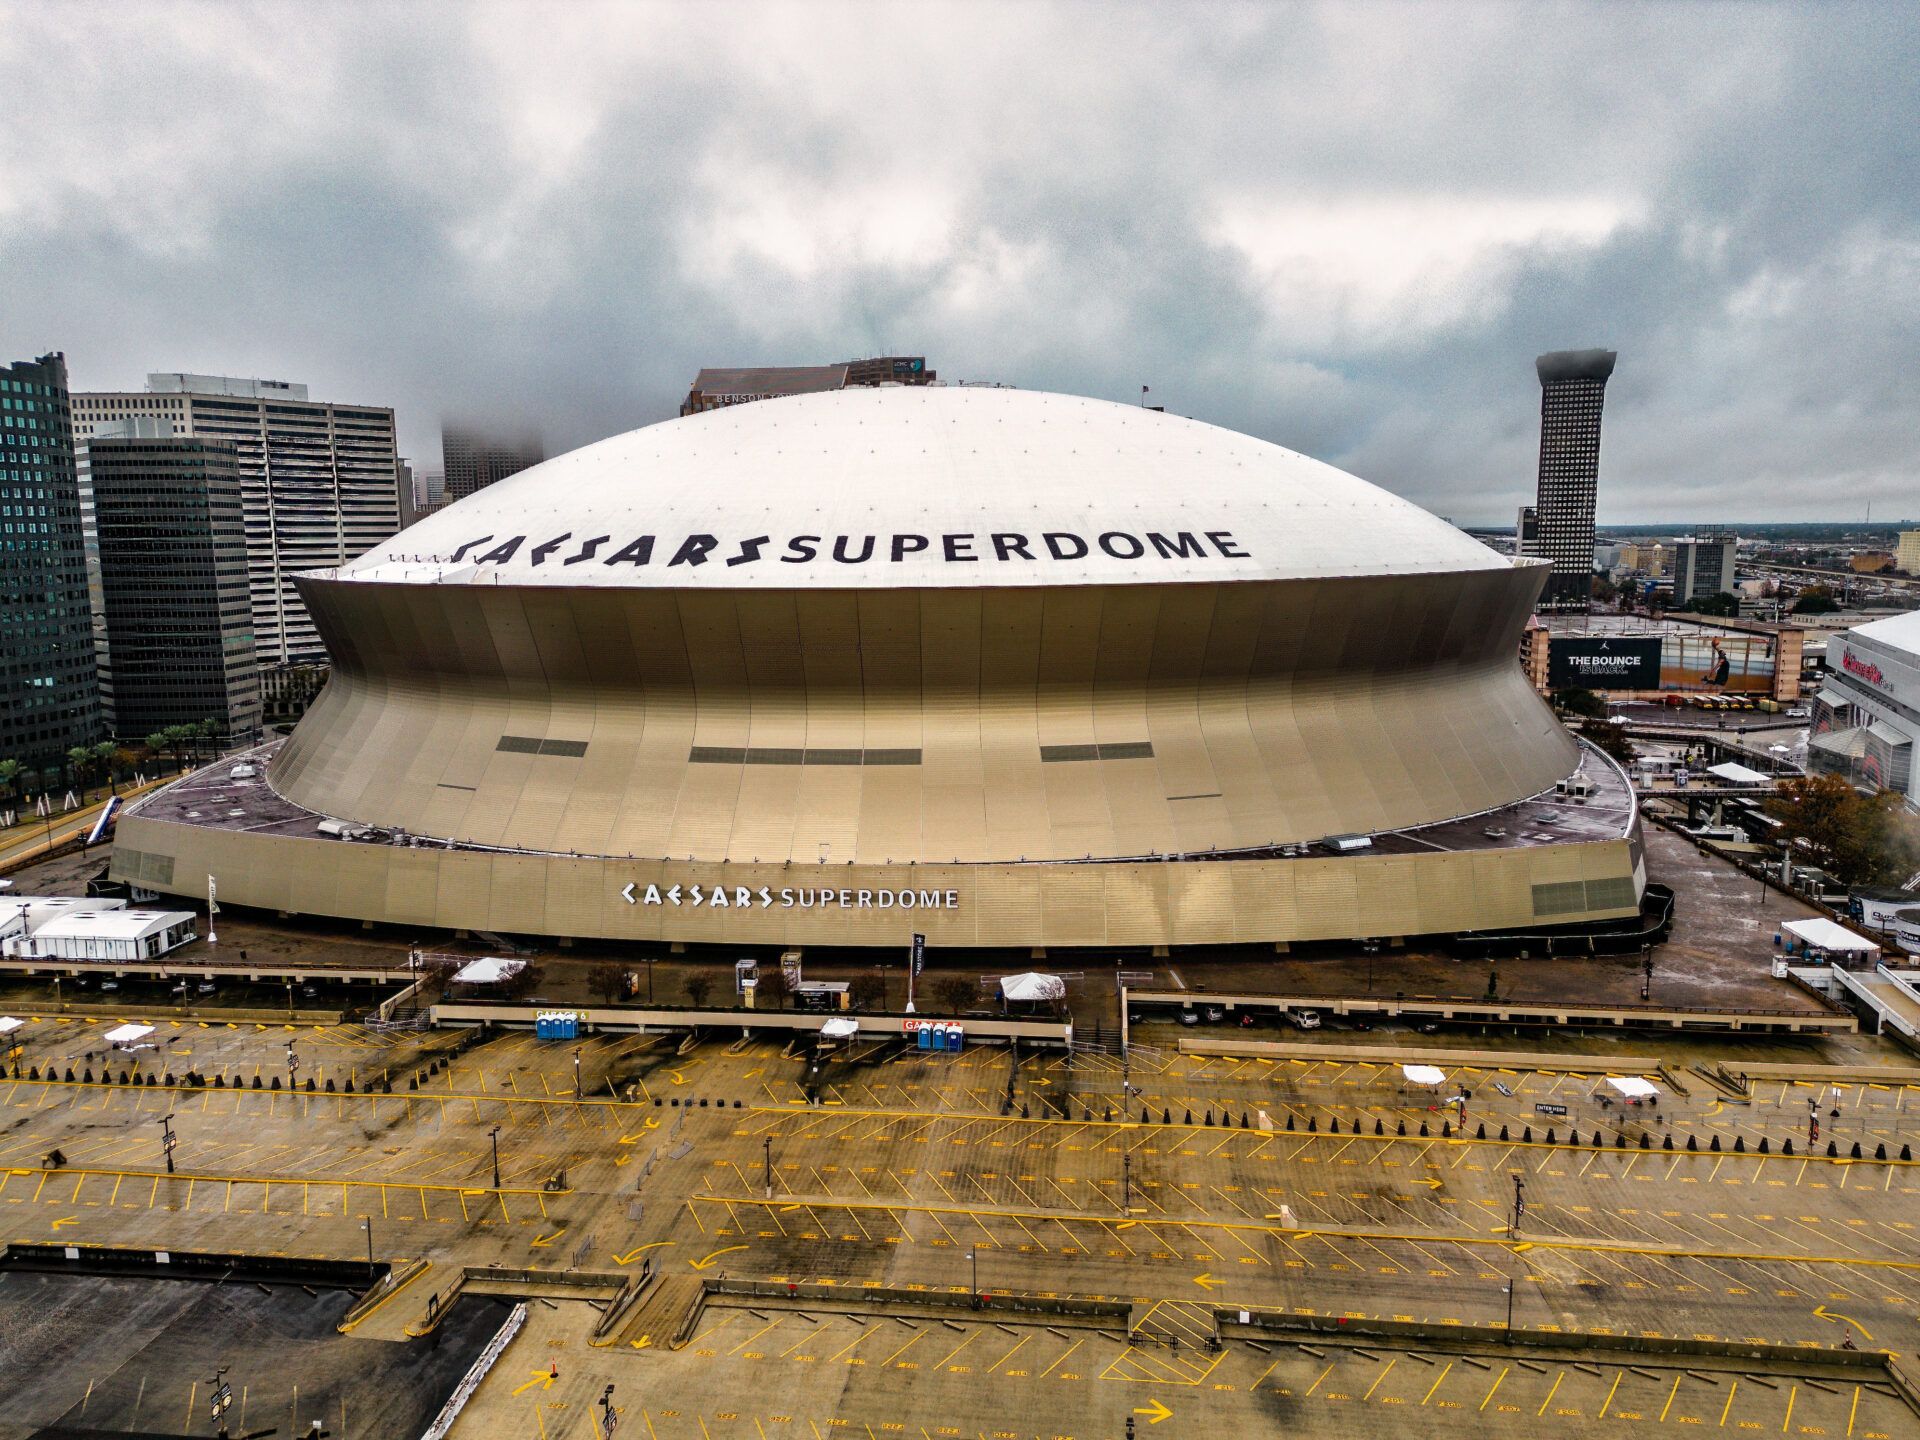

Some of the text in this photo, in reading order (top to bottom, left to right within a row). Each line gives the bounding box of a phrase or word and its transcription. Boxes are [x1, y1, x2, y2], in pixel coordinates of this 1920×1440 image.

[717, 394, 764, 403] BENSON
[451, 531, 1252, 567] CAESARS SUPERDOME
[1568, 656, 1641, 665] THE BOUNCE
[621, 882, 959, 909] CAESARS SUPERDOME
[580, 1012, 586, 1020] 6
